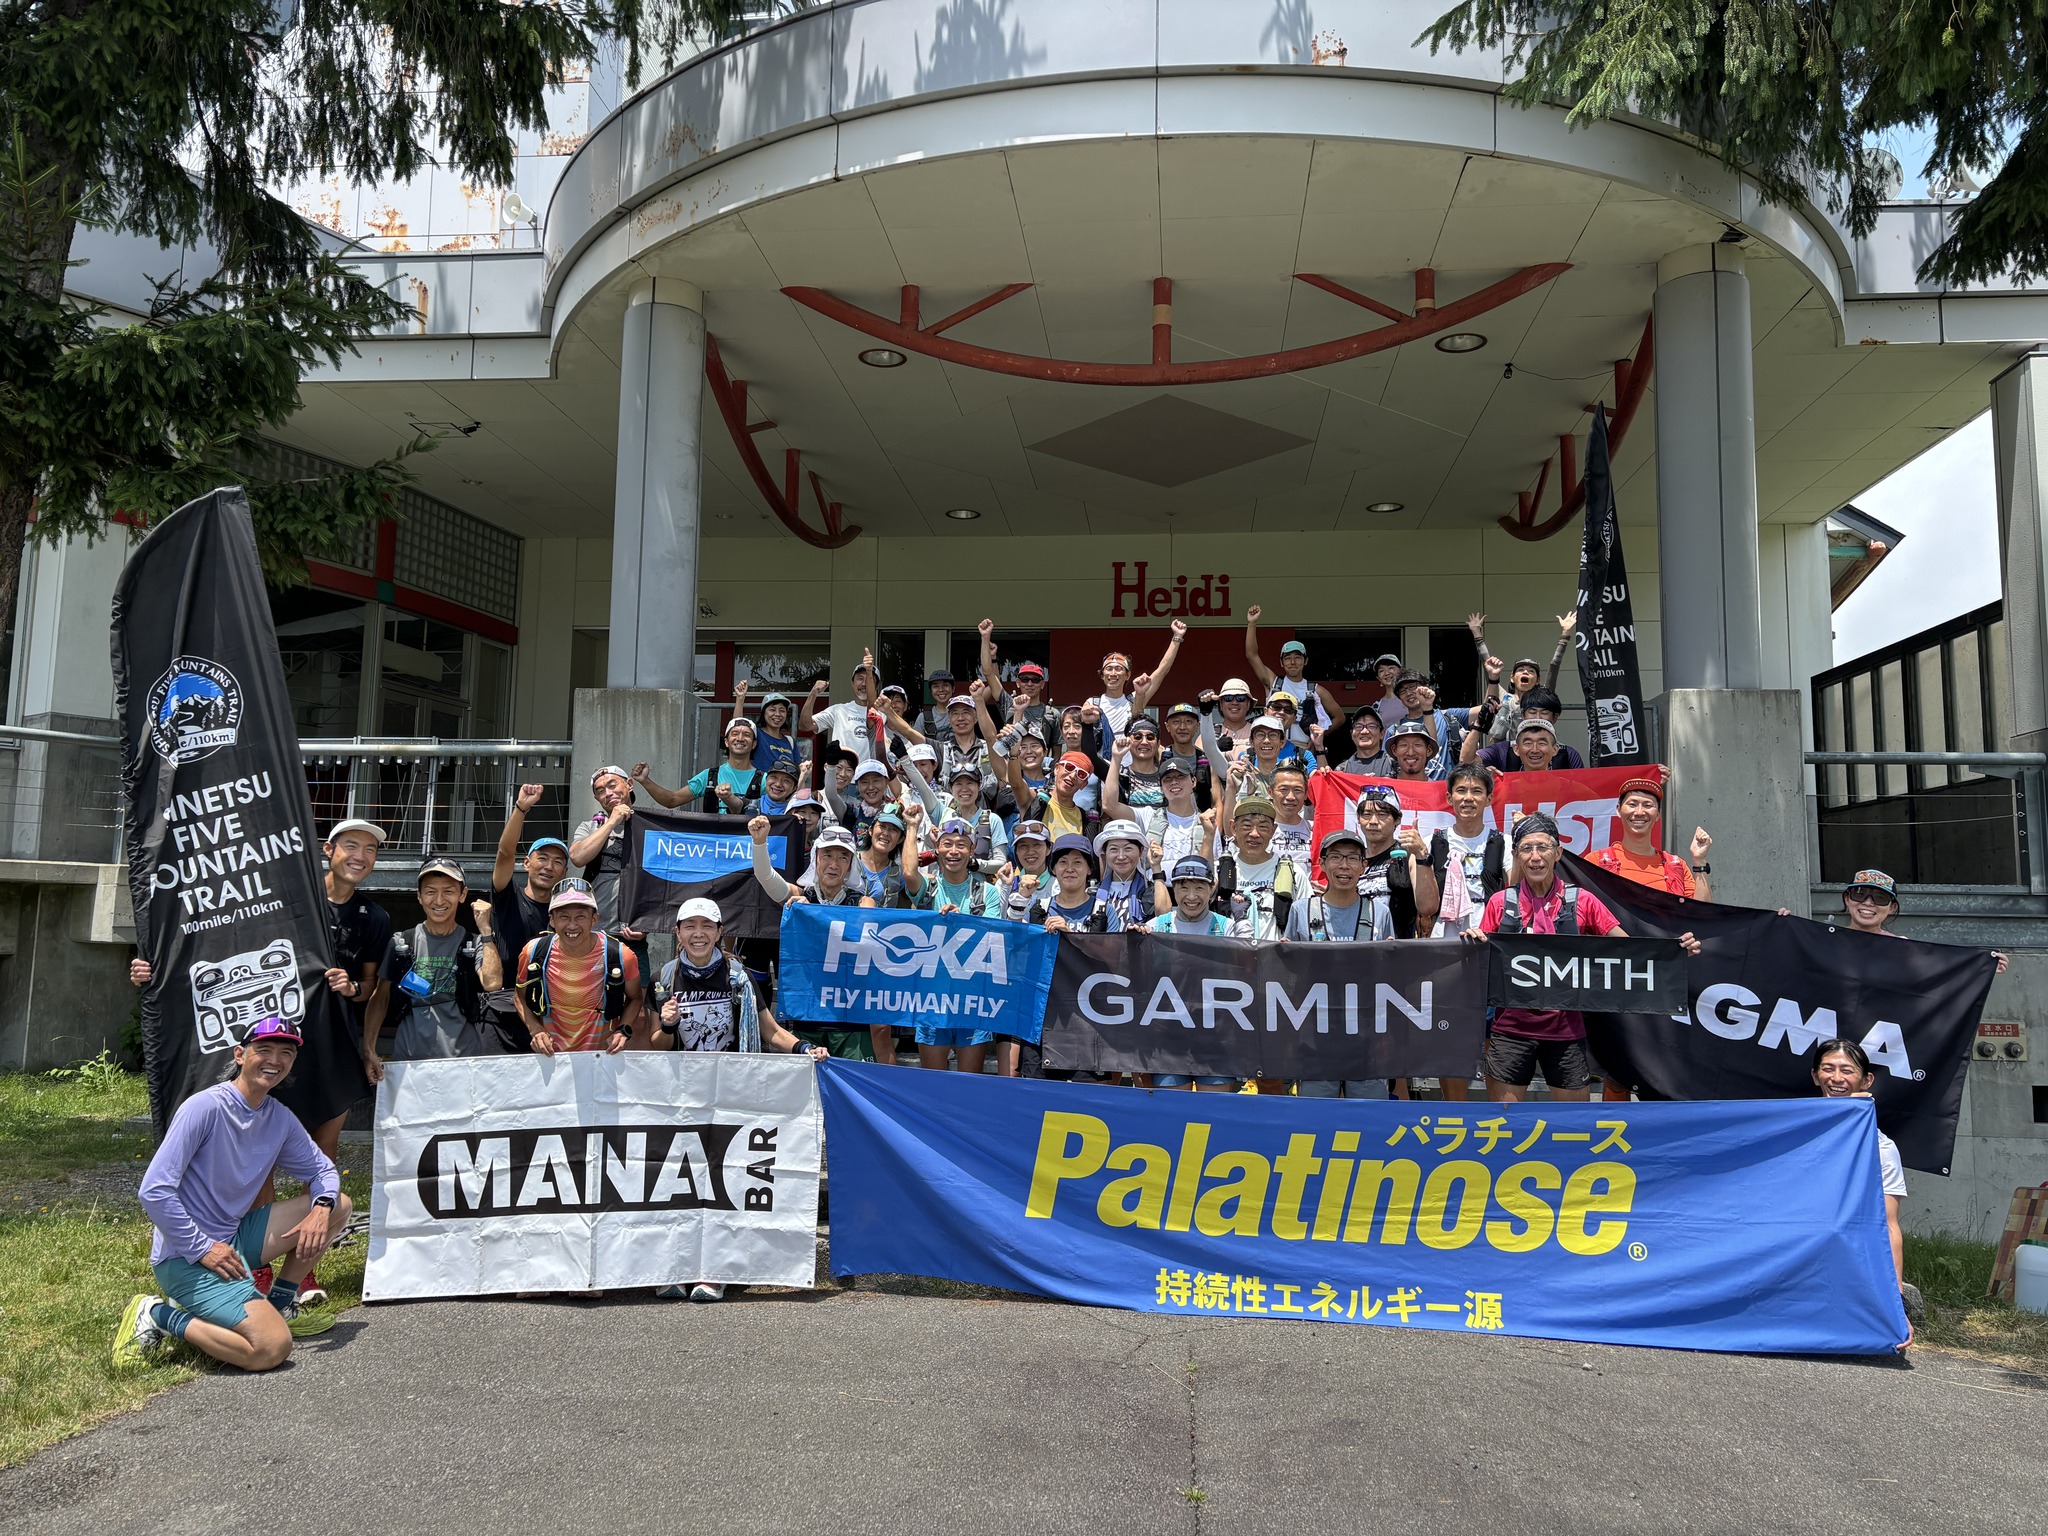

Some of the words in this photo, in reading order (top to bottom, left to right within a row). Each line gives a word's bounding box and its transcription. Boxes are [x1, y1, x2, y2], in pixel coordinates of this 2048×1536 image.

[1111, 561, 1231, 617] Heidi
[225, 688, 239, 725] TRAIL
[172, 812, 244, 853] FIVE
[657, 837, 769, 860] New-HAL
[150, 826, 304, 899] OUNTAINS
[177, 871, 272, 916] TRAIL
[180, 900, 284, 936] 100mile/110km
[823, 920, 1008, 985] HOKA
[1510, 954, 1655, 991] SMITH
[820, 986, 860, 1009] FLY
[864, 989, 960, 1015] HUMAN
[964, 994, 1005, 1018] FLY
[1076, 972, 1433, 1035] GARMIN
[1672, 982, 1913, 1080] GMA
[1385, 1115, 1633, 1155] パラチノース
[437, 1130, 716, 1211] MANA
[744, 1126, 779, 1212] BAR
[1024, 1110, 1638, 1256] Palatinose
[1155, 1267, 1505, 1330] 持続性エネルギー源
